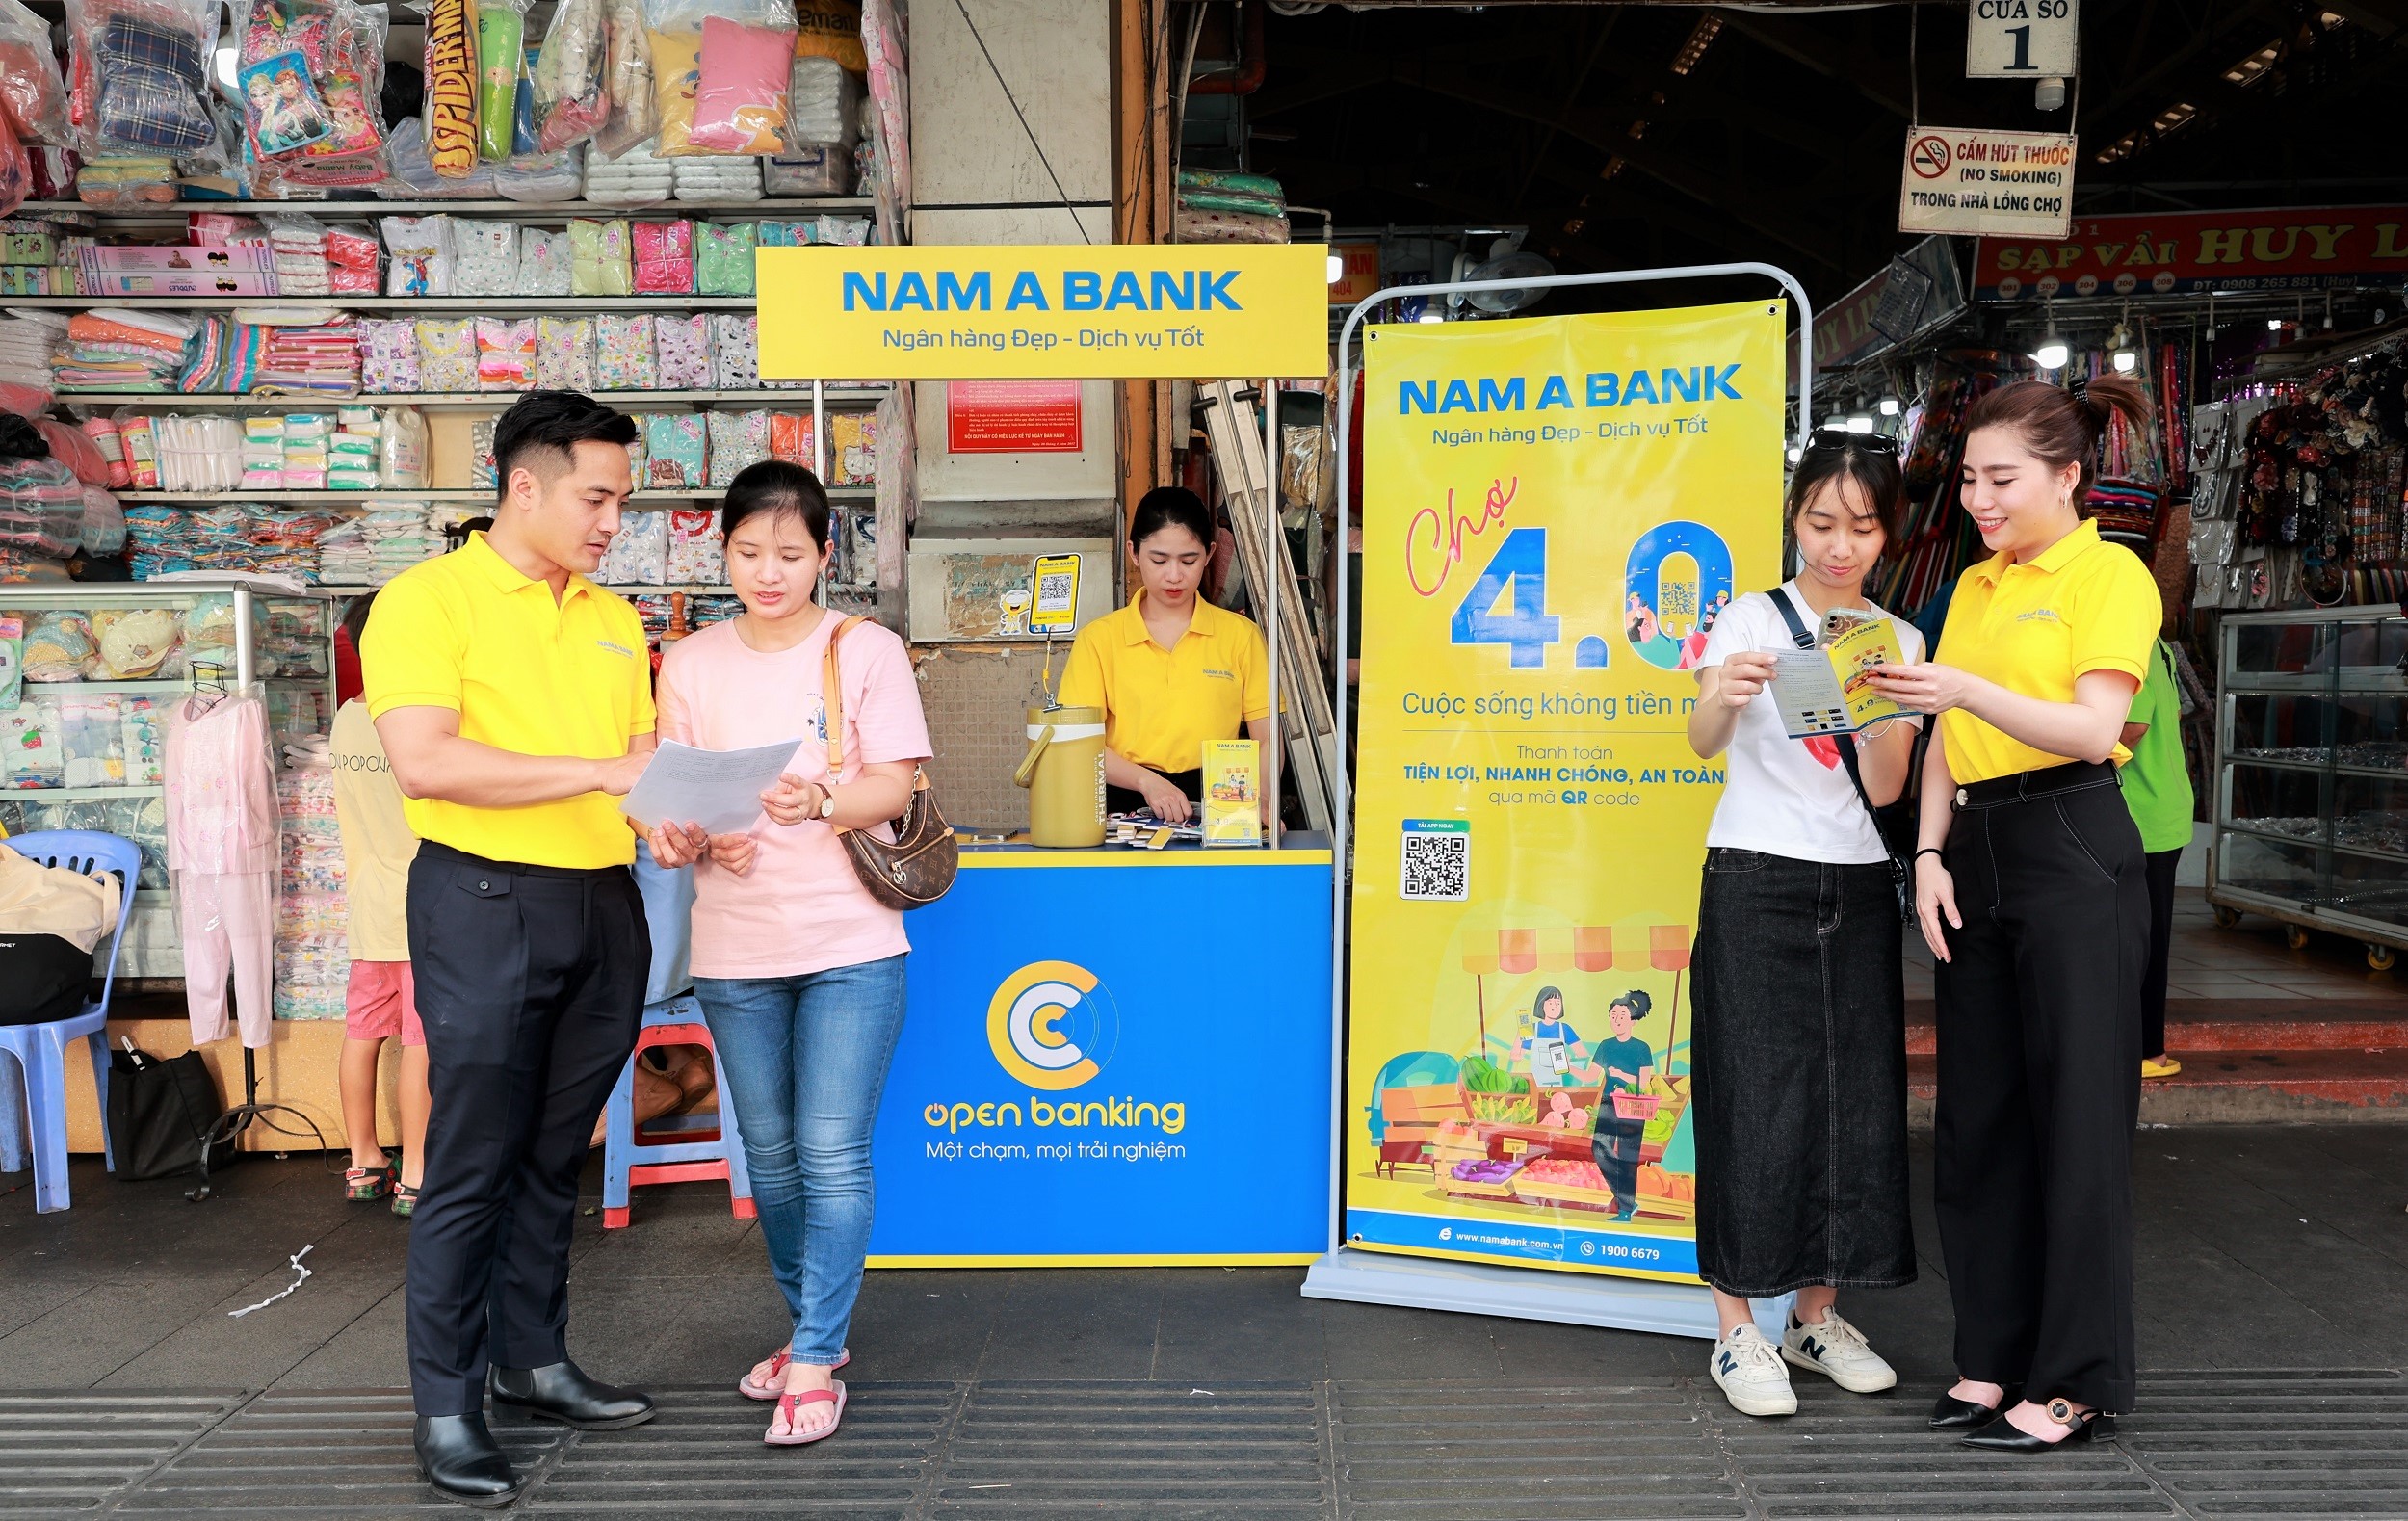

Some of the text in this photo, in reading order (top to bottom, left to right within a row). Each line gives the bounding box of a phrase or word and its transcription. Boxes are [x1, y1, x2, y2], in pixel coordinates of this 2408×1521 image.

[2003, 25, 2038, 70] 1
[1957, 136, 2070, 166] CẤM HÚT THUỐC
[1960, 168, 2062, 187] (NO SMOKING)
[1911, 190, 2063, 217] TRONG NHÀ LỒNG CHỢ
[2088, 223, 2100, 236] 1
[1997, 244, 2085, 275] SẠP
[2093, 230, 2179, 266] VẢI
[2195, 223, 2355, 265] HUY
[842, 271, 1243, 311] NAM A BANK
[1333, 281, 1352, 296] 404
[2002, 283, 2017, 292] 301
[2079, 280, 2095, 289] 304
[2193, 280, 2216, 291] ĐT:
[2220, 278, 2256, 290] 0908
[2262, 277, 2288, 288] 265
[2291, 276, 2317, 287] 881
[2323, 275, 2359, 288] (Huy)
[883, 328, 943, 351] Ngân
[950, 328, 1006, 351] hàng
[1011, 328, 1058, 351] Đẹp
[1078, 328, 1128, 351] Dịch
[1134, 333, 1162, 351] vụ
[1165, 325, 1204, 347] Tốt
[1400, 363, 1744, 415] NAM A BANK
[1432, 427, 1483, 447] Ngân
[1488, 425, 1535, 445] hàng
[1541, 424, 1581, 443] Đẹp
[1599, 421, 1640, 441] Dịch
[1646, 424, 1670, 439] vụ
[1674, 413, 1708, 433] Tốt
[1405, 476, 1518, 597] Chợ
[1450, 520, 1734, 670] 4.0
[1834, 637, 1852, 651] NAM
[1857, 623, 1881, 635] BANK
[1402, 692, 1466, 719] Cuộc
[1474, 689, 1533, 720] sống
[1540, 692, 1617, 720] không
[1625, 689, 1672, 715] tiền
[1517, 745, 1613, 760] Thanh toán
[1403, 762, 1440, 784] TIỆN
[1446, 764, 1479, 784] LỢI,
[1486, 767, 1551, 781] NHANH
[1557, 763, 1634, 785] CHÓNG,
[1639, 769, 1666, 783] AN
[1489, 789, 1640, 806] qua mã QR code
[924, 1095, 1186, 1135] open banking
[926, 1140, 1186, 1162] Một chạm, mọi trải nghiệm
[1456, 1231, 1564, 1250] www.namabank.com.vn
[1600, 1244, 1660, 1260] 1900 6679
